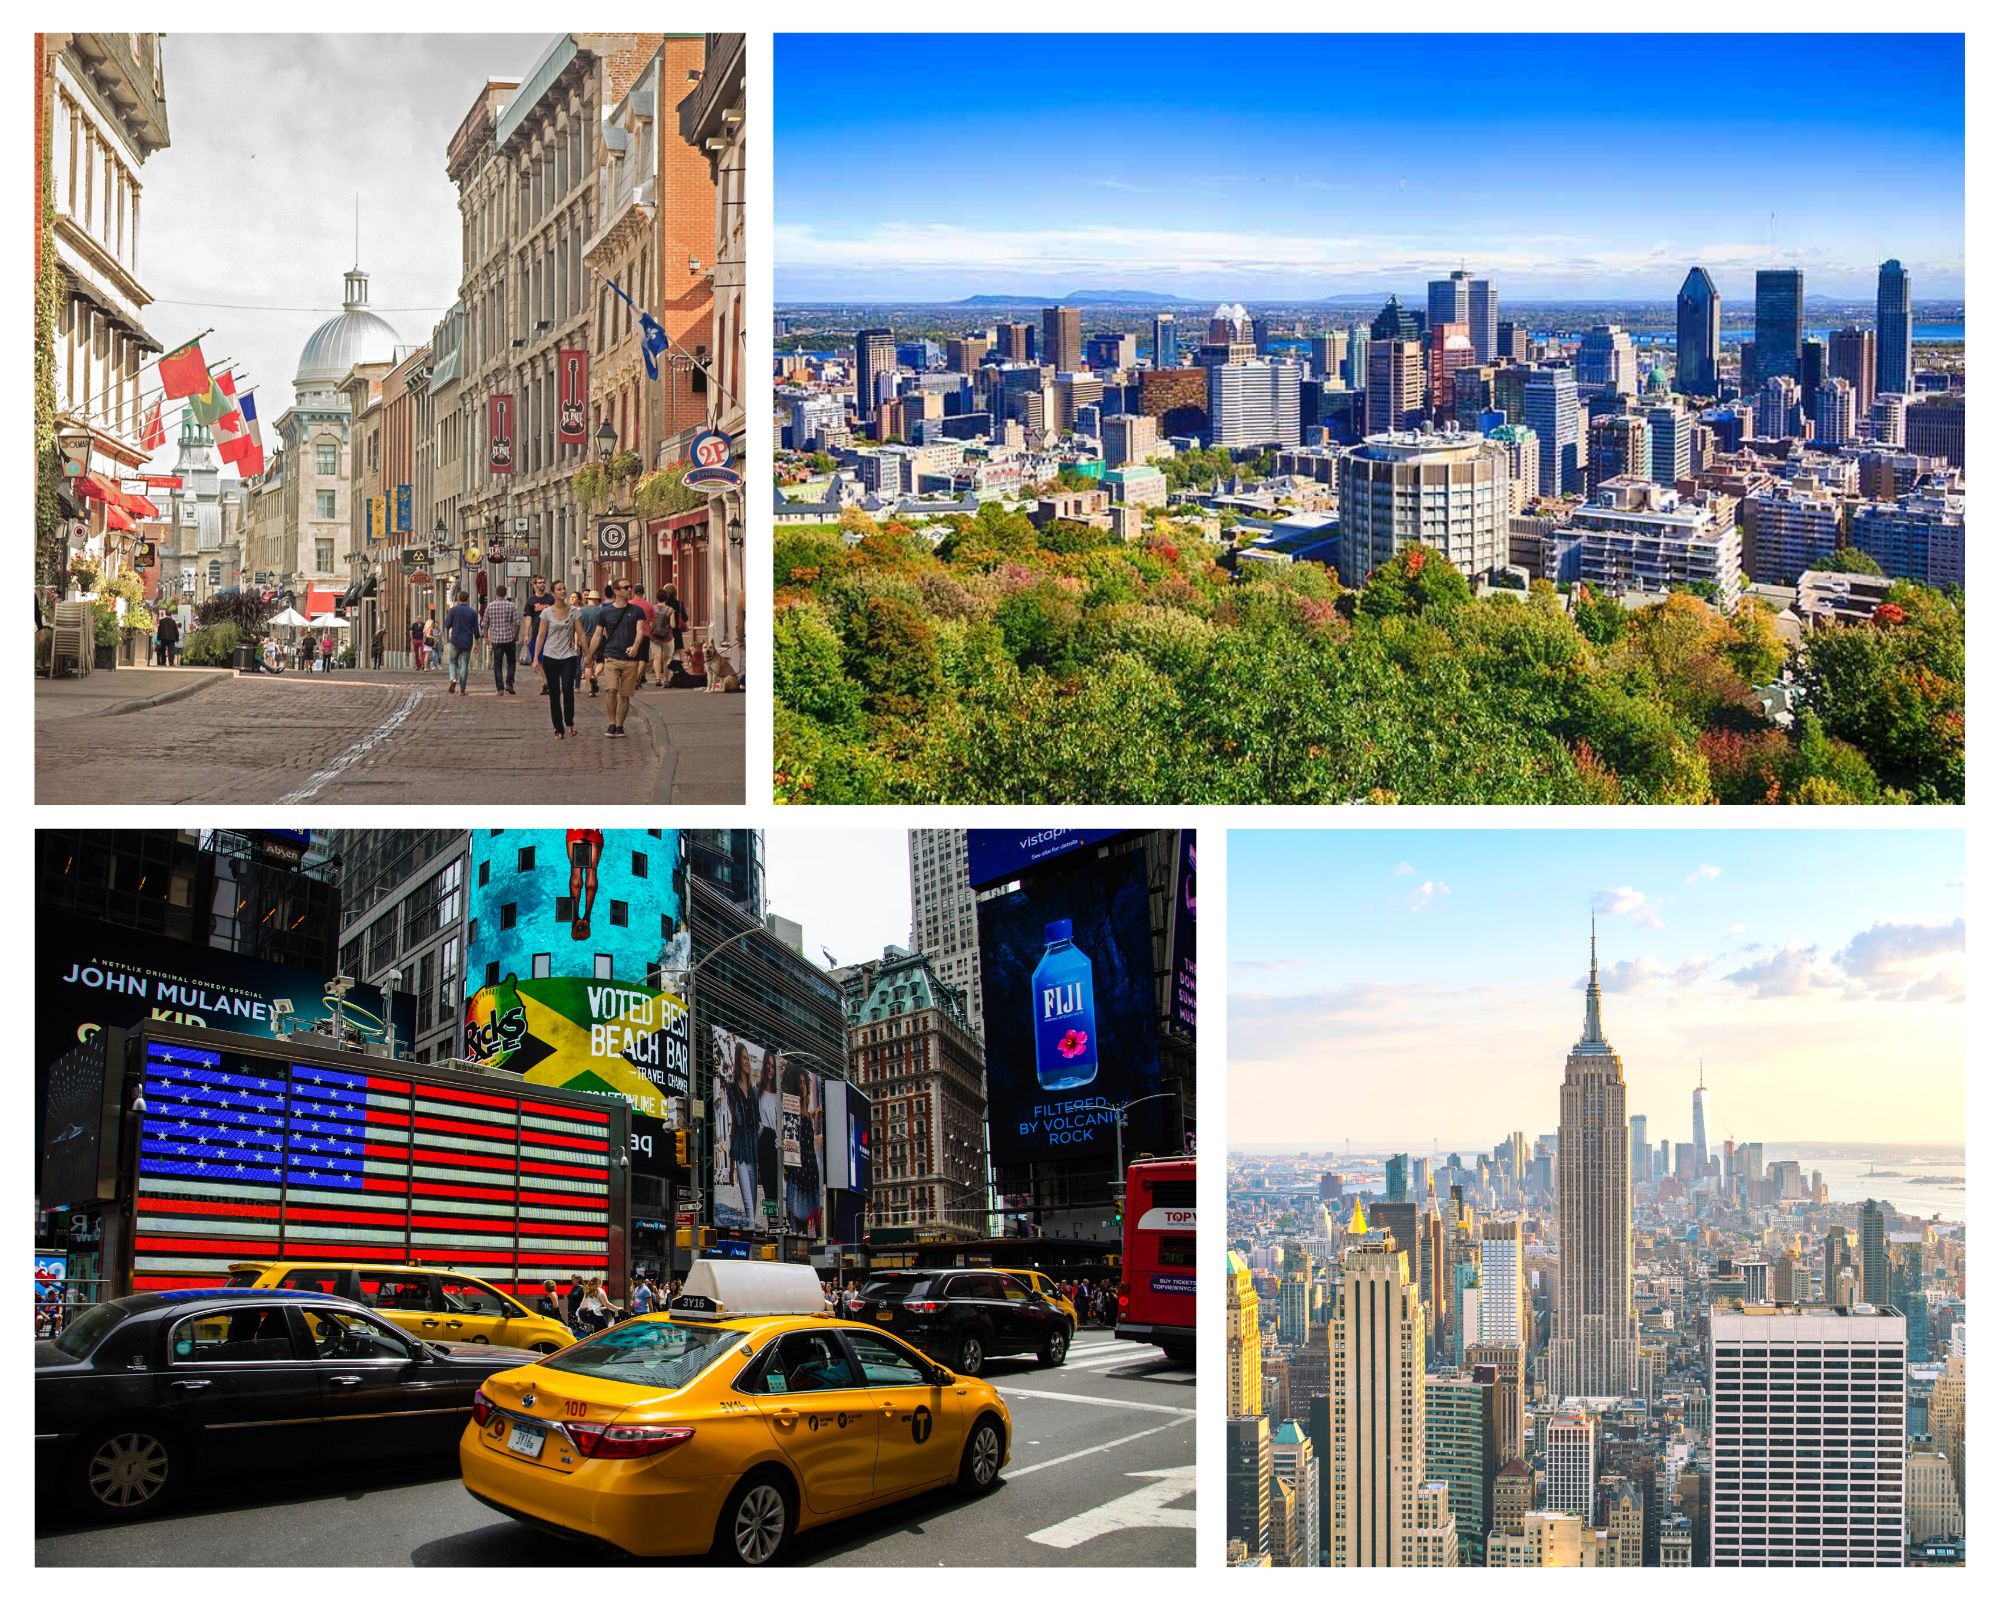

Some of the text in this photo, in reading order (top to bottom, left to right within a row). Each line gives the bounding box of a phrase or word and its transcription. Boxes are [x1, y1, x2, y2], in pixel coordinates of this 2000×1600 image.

[699, 441, 728, 466] 2P
[63, 963, 147, 998] JOHN
[102, 959, 142, 973] NETFLIX
[146, 969, 188, 983] ORIGINAL
[192, 979, 226, 991] COMEDY
[229, 987, 263, 999] SPECIAL
[1043, 982, 1084, 1018] FIJI
[587, 986, 689, 1041] VOTED BEST
[591, 1023, 689, 1076] BEACH BAR
[667, 1073, 688, 1094] CHANNEL
[1034, 1096, 1107, 1118] FILTERED
[1019, 1121, 1038, 1135] BY
[1049, 1128, 1094, 1145] ROCK
[683, 1297, 705, 1308] 3Y16
[565, 1401, 587, 1417] 100
[720, 1401, 749, 1414] 3Y16
